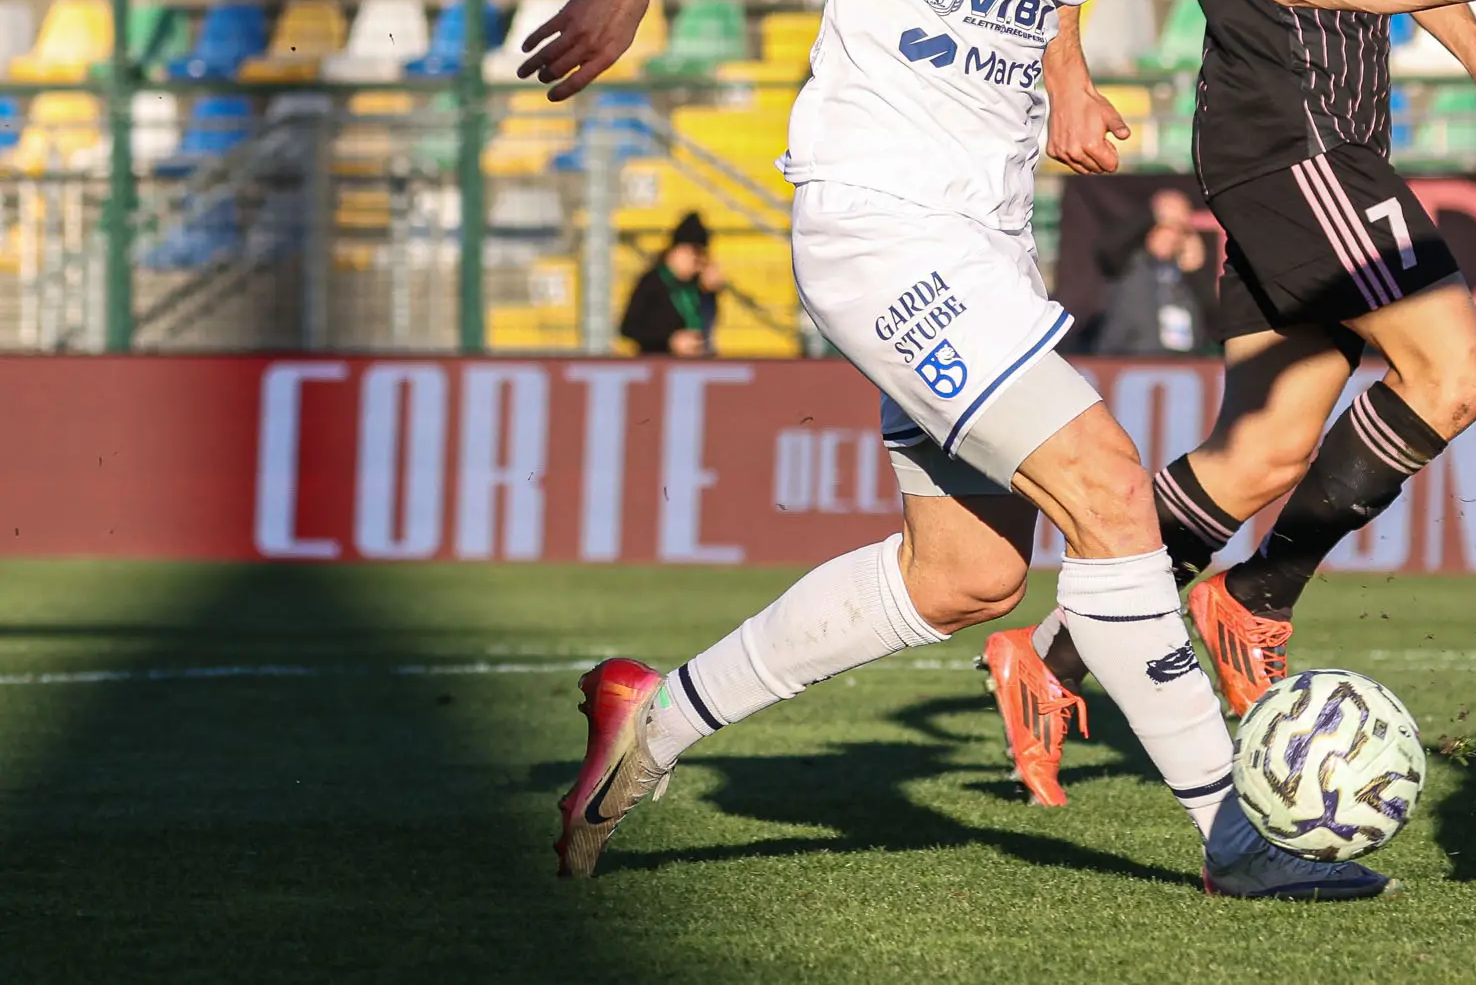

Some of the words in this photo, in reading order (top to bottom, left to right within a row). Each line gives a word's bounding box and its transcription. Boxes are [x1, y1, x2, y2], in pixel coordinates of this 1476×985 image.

[1365, 196, 1418, 270] 7
[874, 271, 950, 341] GARDA
[894, 294, 967, 364] STUBE
[255, 362, 755, 563] CORTE
